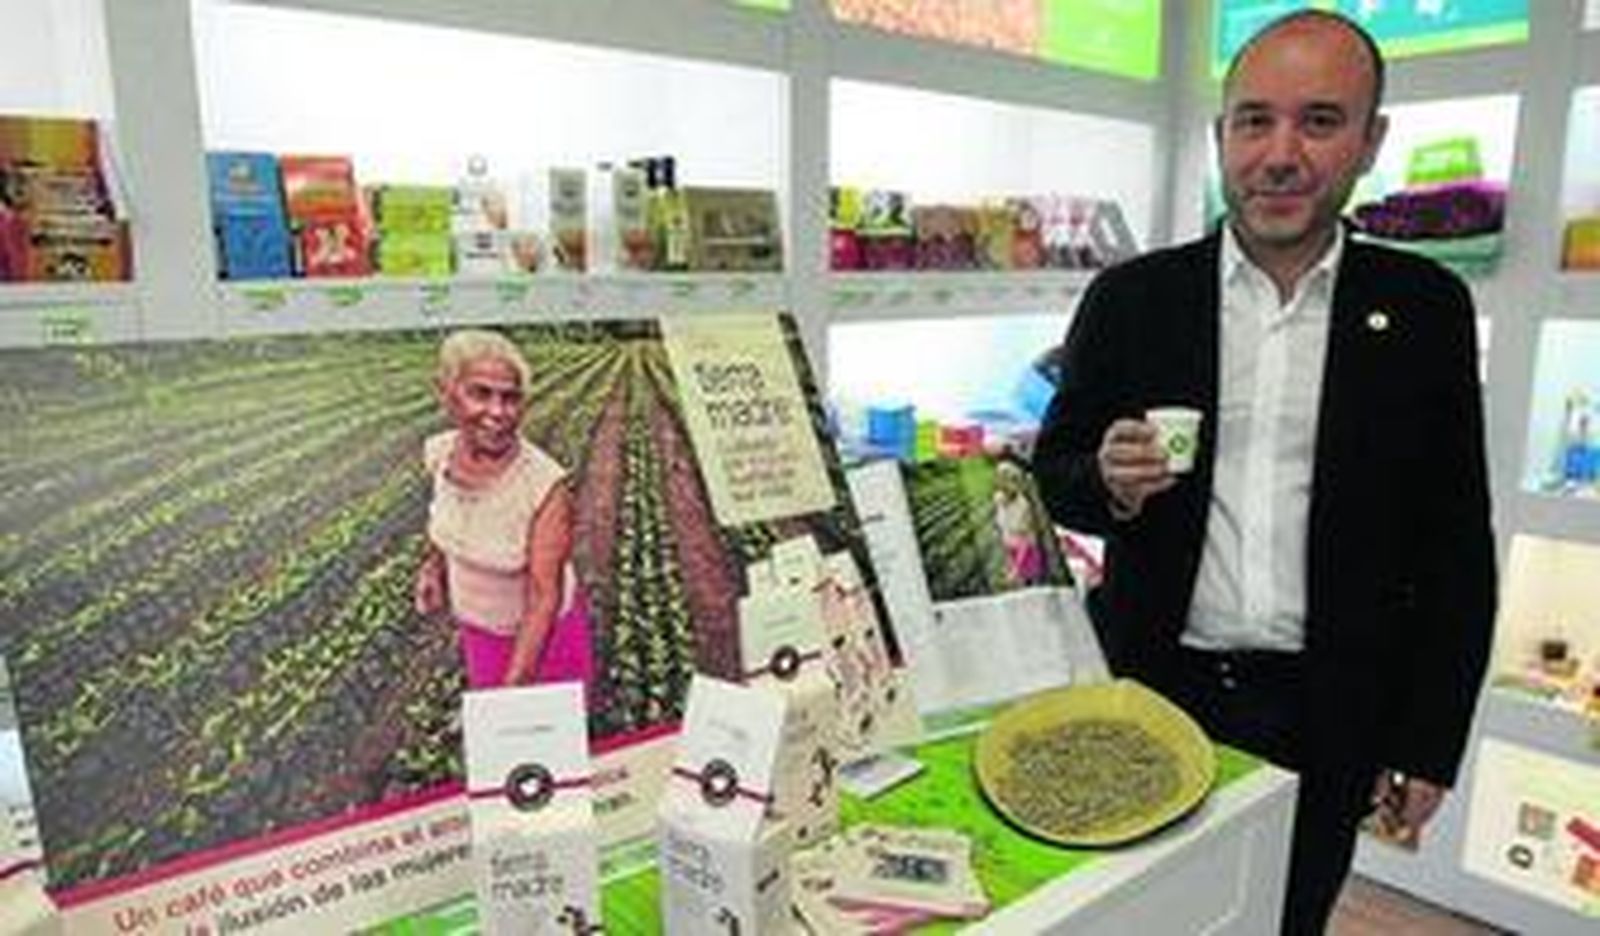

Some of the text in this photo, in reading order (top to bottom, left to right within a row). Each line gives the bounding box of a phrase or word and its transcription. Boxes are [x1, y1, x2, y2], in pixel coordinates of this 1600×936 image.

[113, 906, 159, 932] Un
[165, 881, 226, 918] café
[232, 867, 284, 902] que
[289, 831, 397, 882] combina
[219, 891, 308, 936] ilusión
[311, 881, 345, 907] de
[349, 867, 386, 895] las
